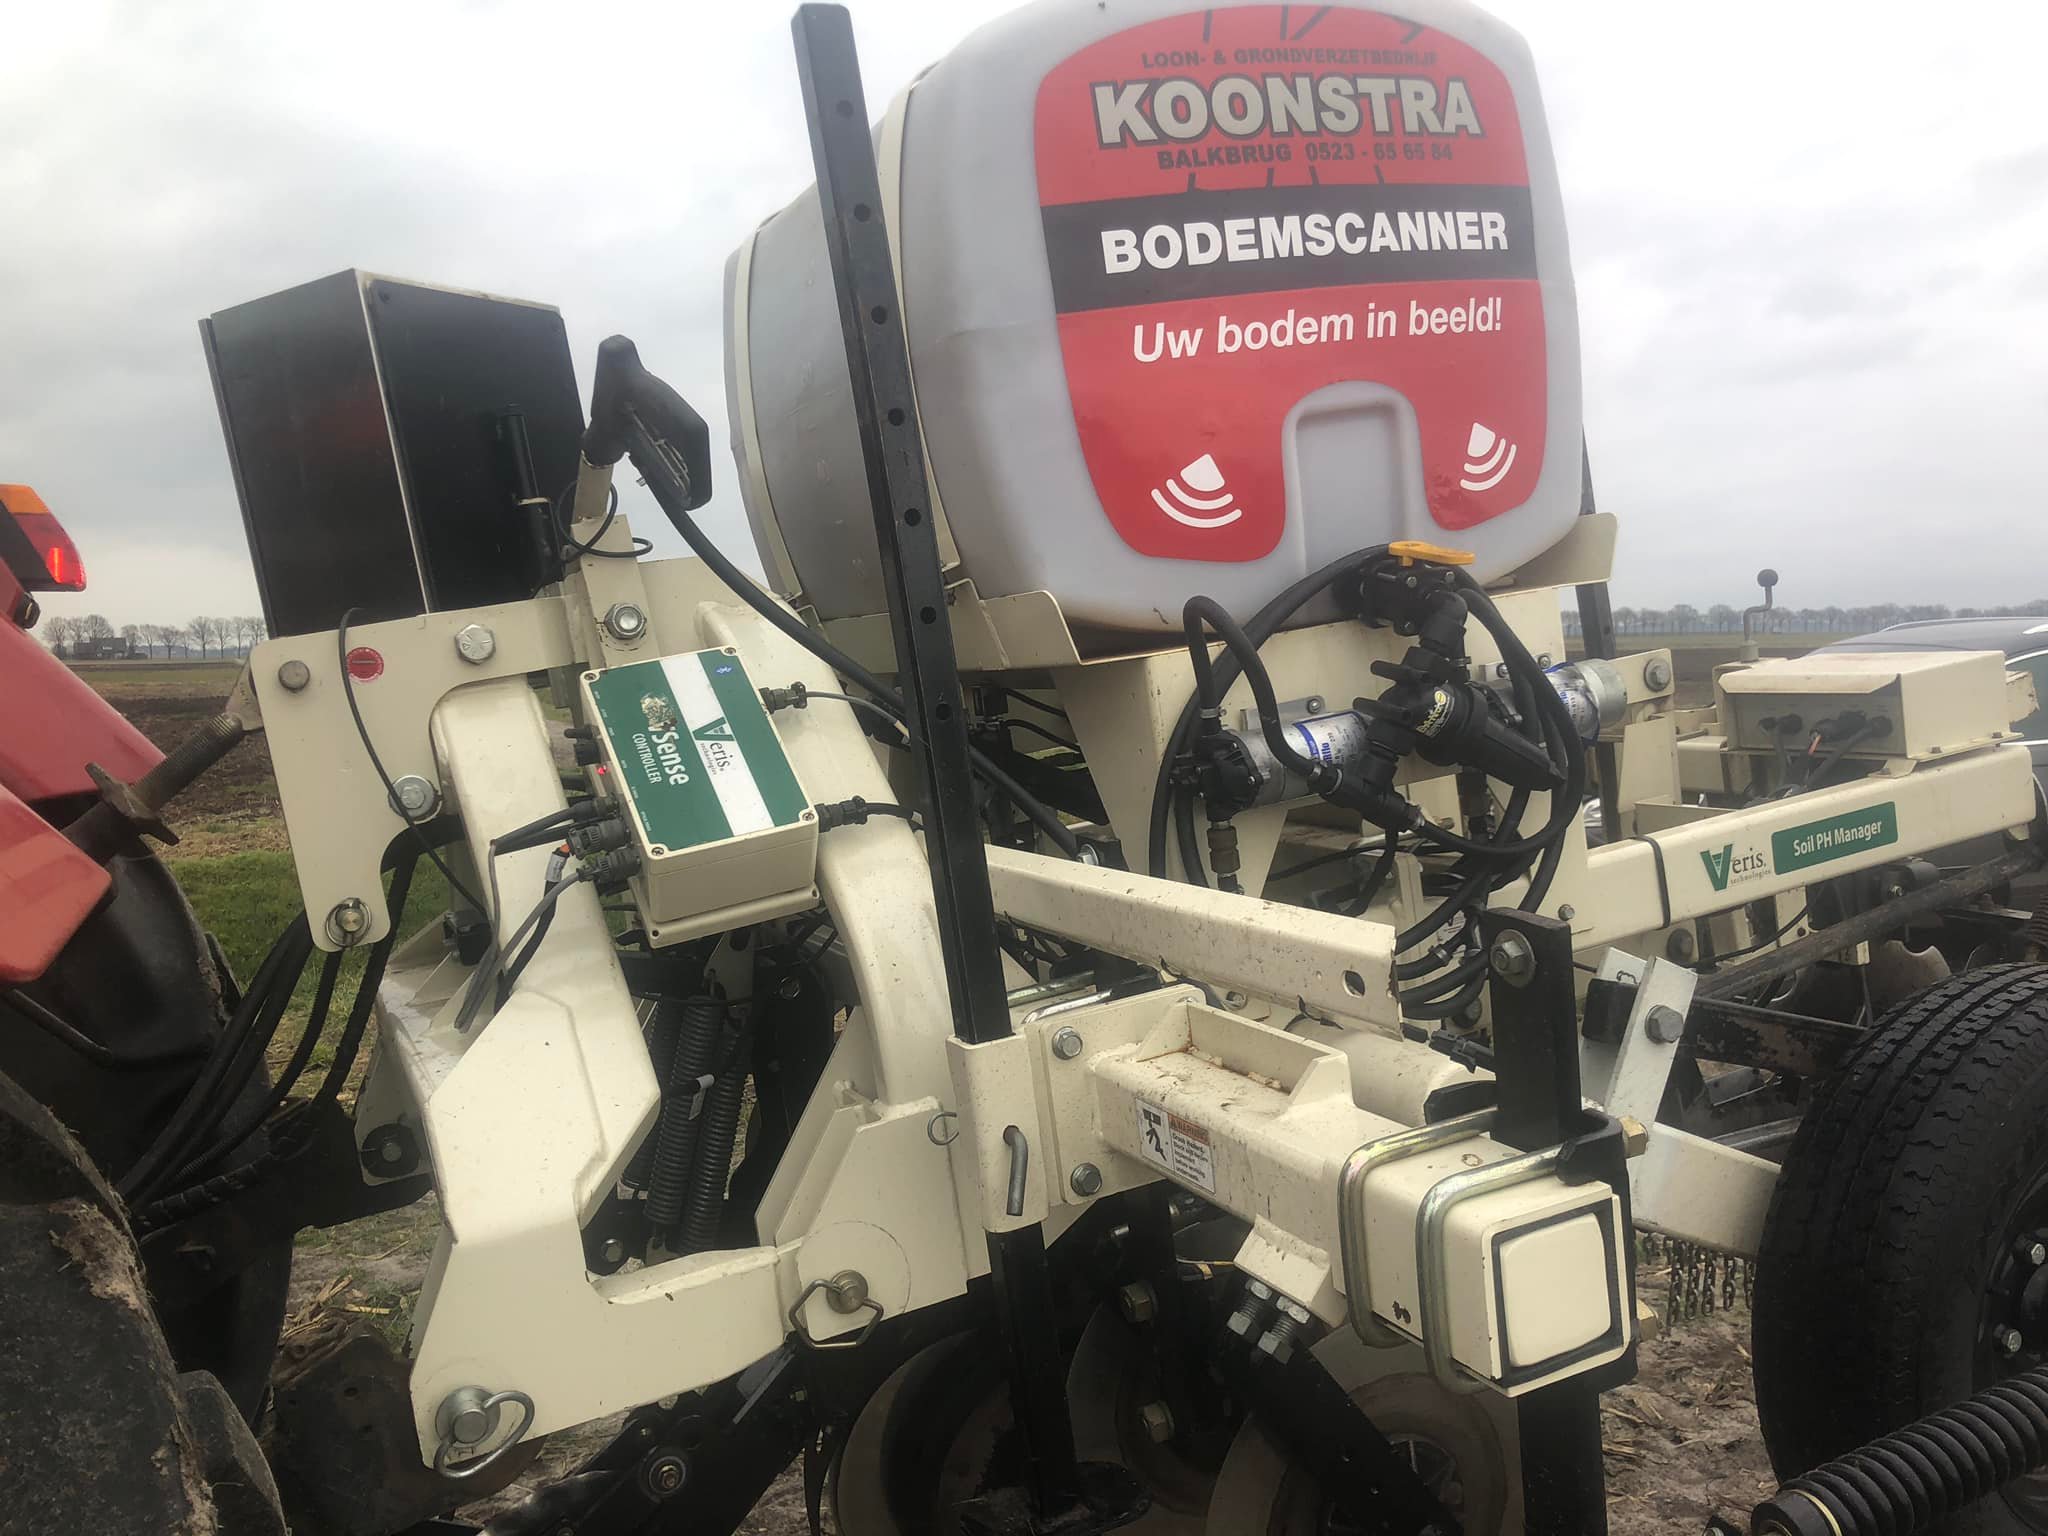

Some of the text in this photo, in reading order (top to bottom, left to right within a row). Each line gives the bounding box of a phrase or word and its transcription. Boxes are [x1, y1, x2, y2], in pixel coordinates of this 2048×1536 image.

[1142, 51, 1206, 69] LOON-
[1213, 50, 1227, 66] &
[1092, 75, 1484, 147] KOONSTRA
[1157, 144, 1292, 170] BALKBRUG
[1304, 142, 1355, 162] 0523
[1101, 211, 1509, 275] BODEMSCANNER
[1132, 296, 1502, 363] Uw bodem in beeld!
[632, 733, 663, 784] CONTROLLER
[692, 716, 736, 772] Veris
[1793, 820, 1882, 857] Soil PH Manager
[1700, 843, 1767, 892] Veris
